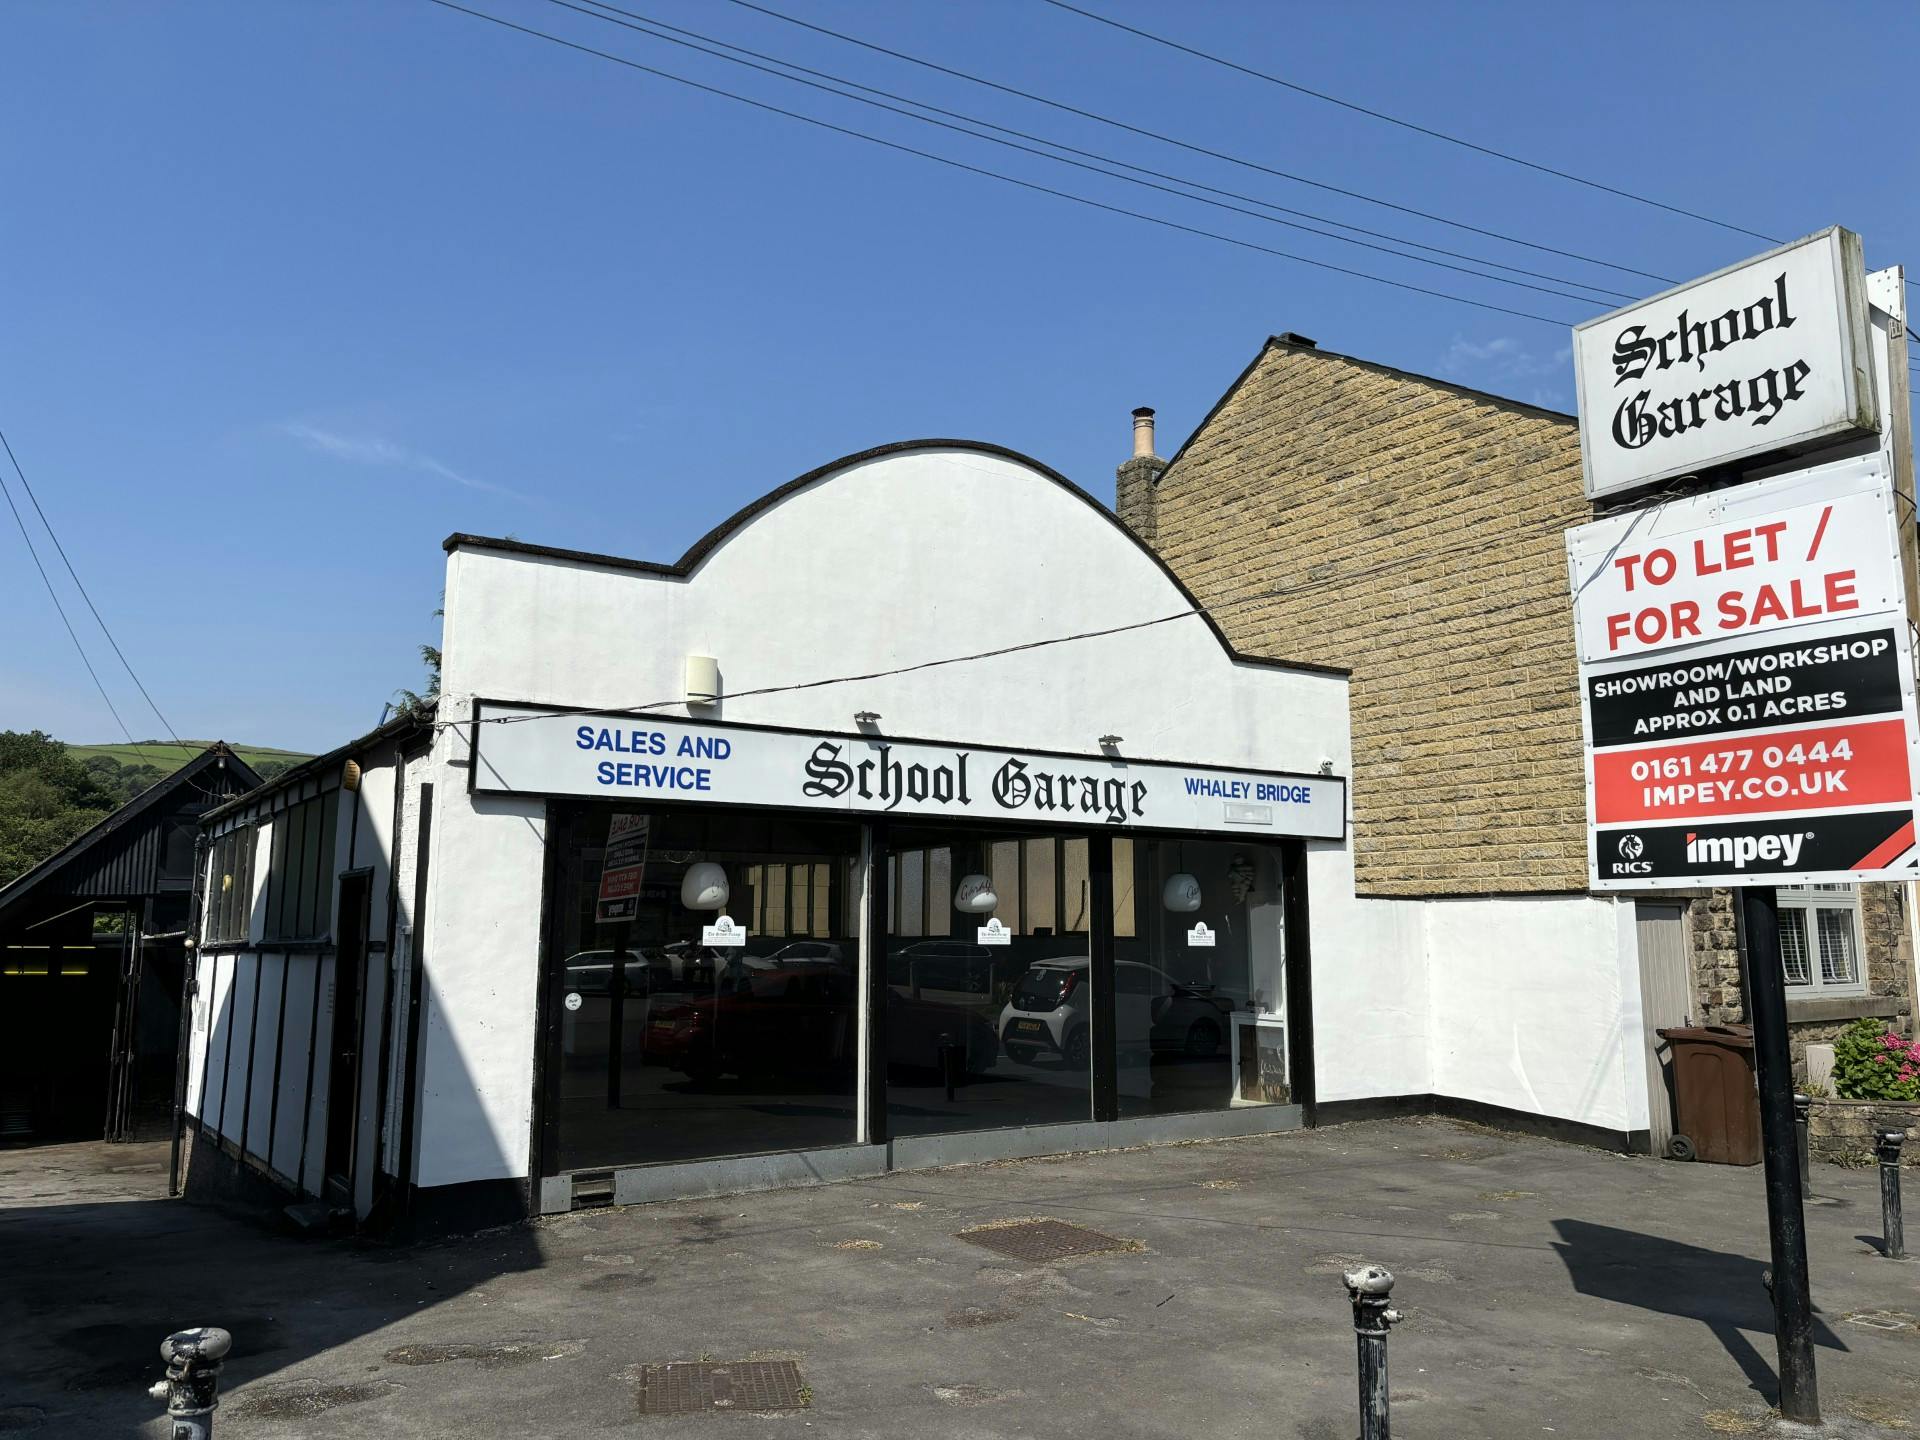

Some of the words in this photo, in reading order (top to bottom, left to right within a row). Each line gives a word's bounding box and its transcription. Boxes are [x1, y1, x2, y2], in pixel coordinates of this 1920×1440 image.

[1612, 271, 1797, 388] School
[1611, 358, 1811, 450] Garage
[1615, 548, 1677, 592] TO
[1694, 521, 1788, 577] LET
[1806, 506, 1833, 562] /
[1607, 600, 1702, 652] FOR
[1717, 569, 1860, 631] SALE
[1594, 638, 1889, 698] SHOWROOM/WORKSHOP
[1633, 708, 1723, 735] APPROX
[1727, 702, 1757, 722] 0.1
[1762, 691, 1847, 718] ACRES
[1673, 686, 1721, 708] AND
[1725, 675, 1793, 700] LAND
[576, 725, 666, 756] SALES
[677, 735, 731, 760] AND
[1630, 755, 1692, 782] 0161
[1699, 749, 1753, 774] 477
[1762, 738, 1854, 769] 0444
[597, 761, 712, 791] SERVICE
[802, 741, 972, 811] School
[991, 757, 1148, 823] Garage
[1184, 778, 1251, 800] WHALEY
[1256, 783, 1311, 804] BRIDGE
[1643, 769, 1849, 808] IMPEY.CO.UK
[1612, 861, 1652, 874] RICS
